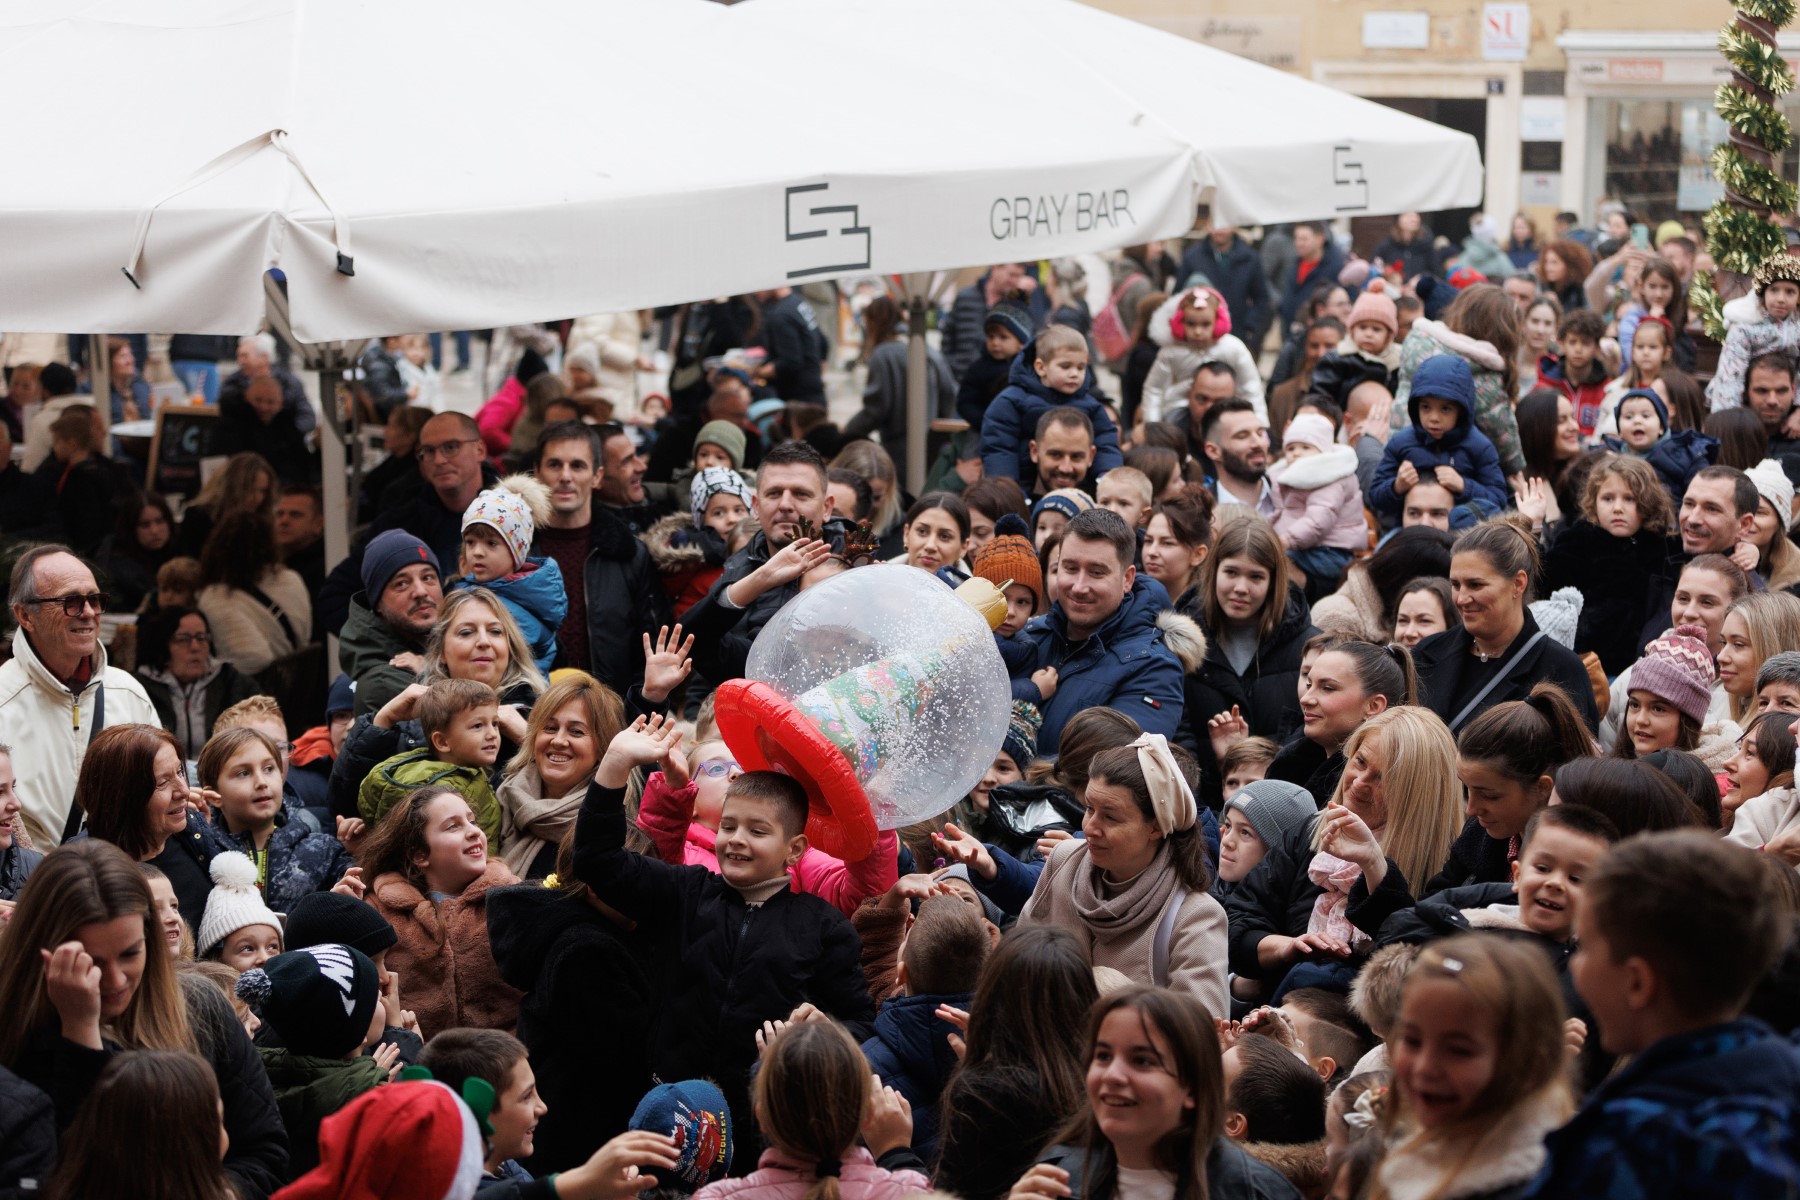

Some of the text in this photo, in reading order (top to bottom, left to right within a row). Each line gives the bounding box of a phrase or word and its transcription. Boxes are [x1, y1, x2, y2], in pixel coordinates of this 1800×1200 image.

[990, 189, 1136, 240] GRAY BAR
[295, 943, 354, 994] NIK
